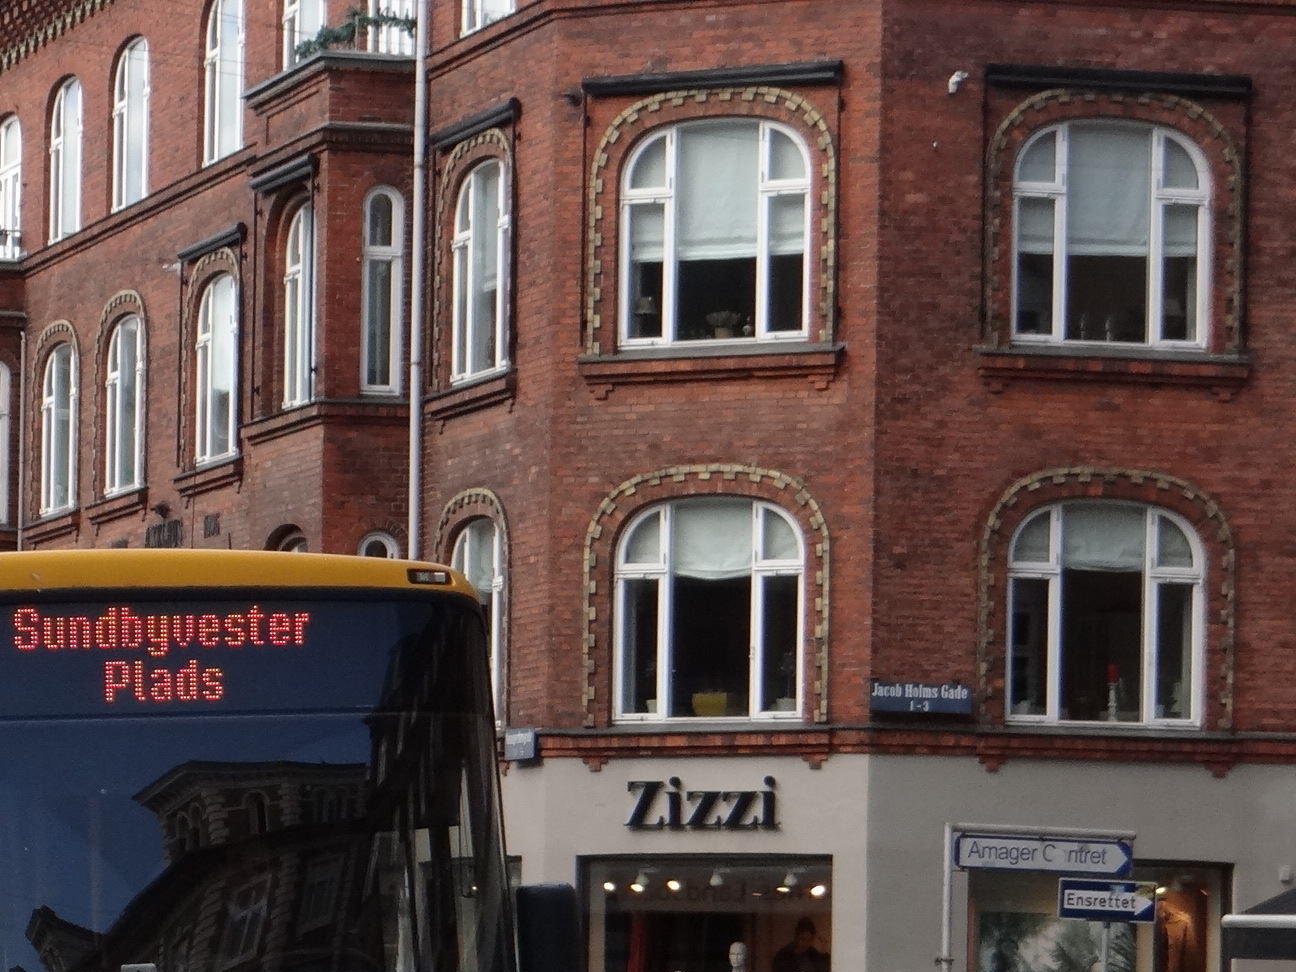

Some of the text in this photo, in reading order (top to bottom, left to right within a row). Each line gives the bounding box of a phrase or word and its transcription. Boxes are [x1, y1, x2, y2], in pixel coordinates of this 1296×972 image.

[13, 605, 311, 657] Sundbyvester
[104, 659, 224, 702] Plads
[872, 683, 968, 699] Jacob Holms Gade
[624, 775, 782, 831] Zizzi
[967, 840, 1107, 865] Amager Cntret
[1066, 892, 1136, 909] Ensrettet
